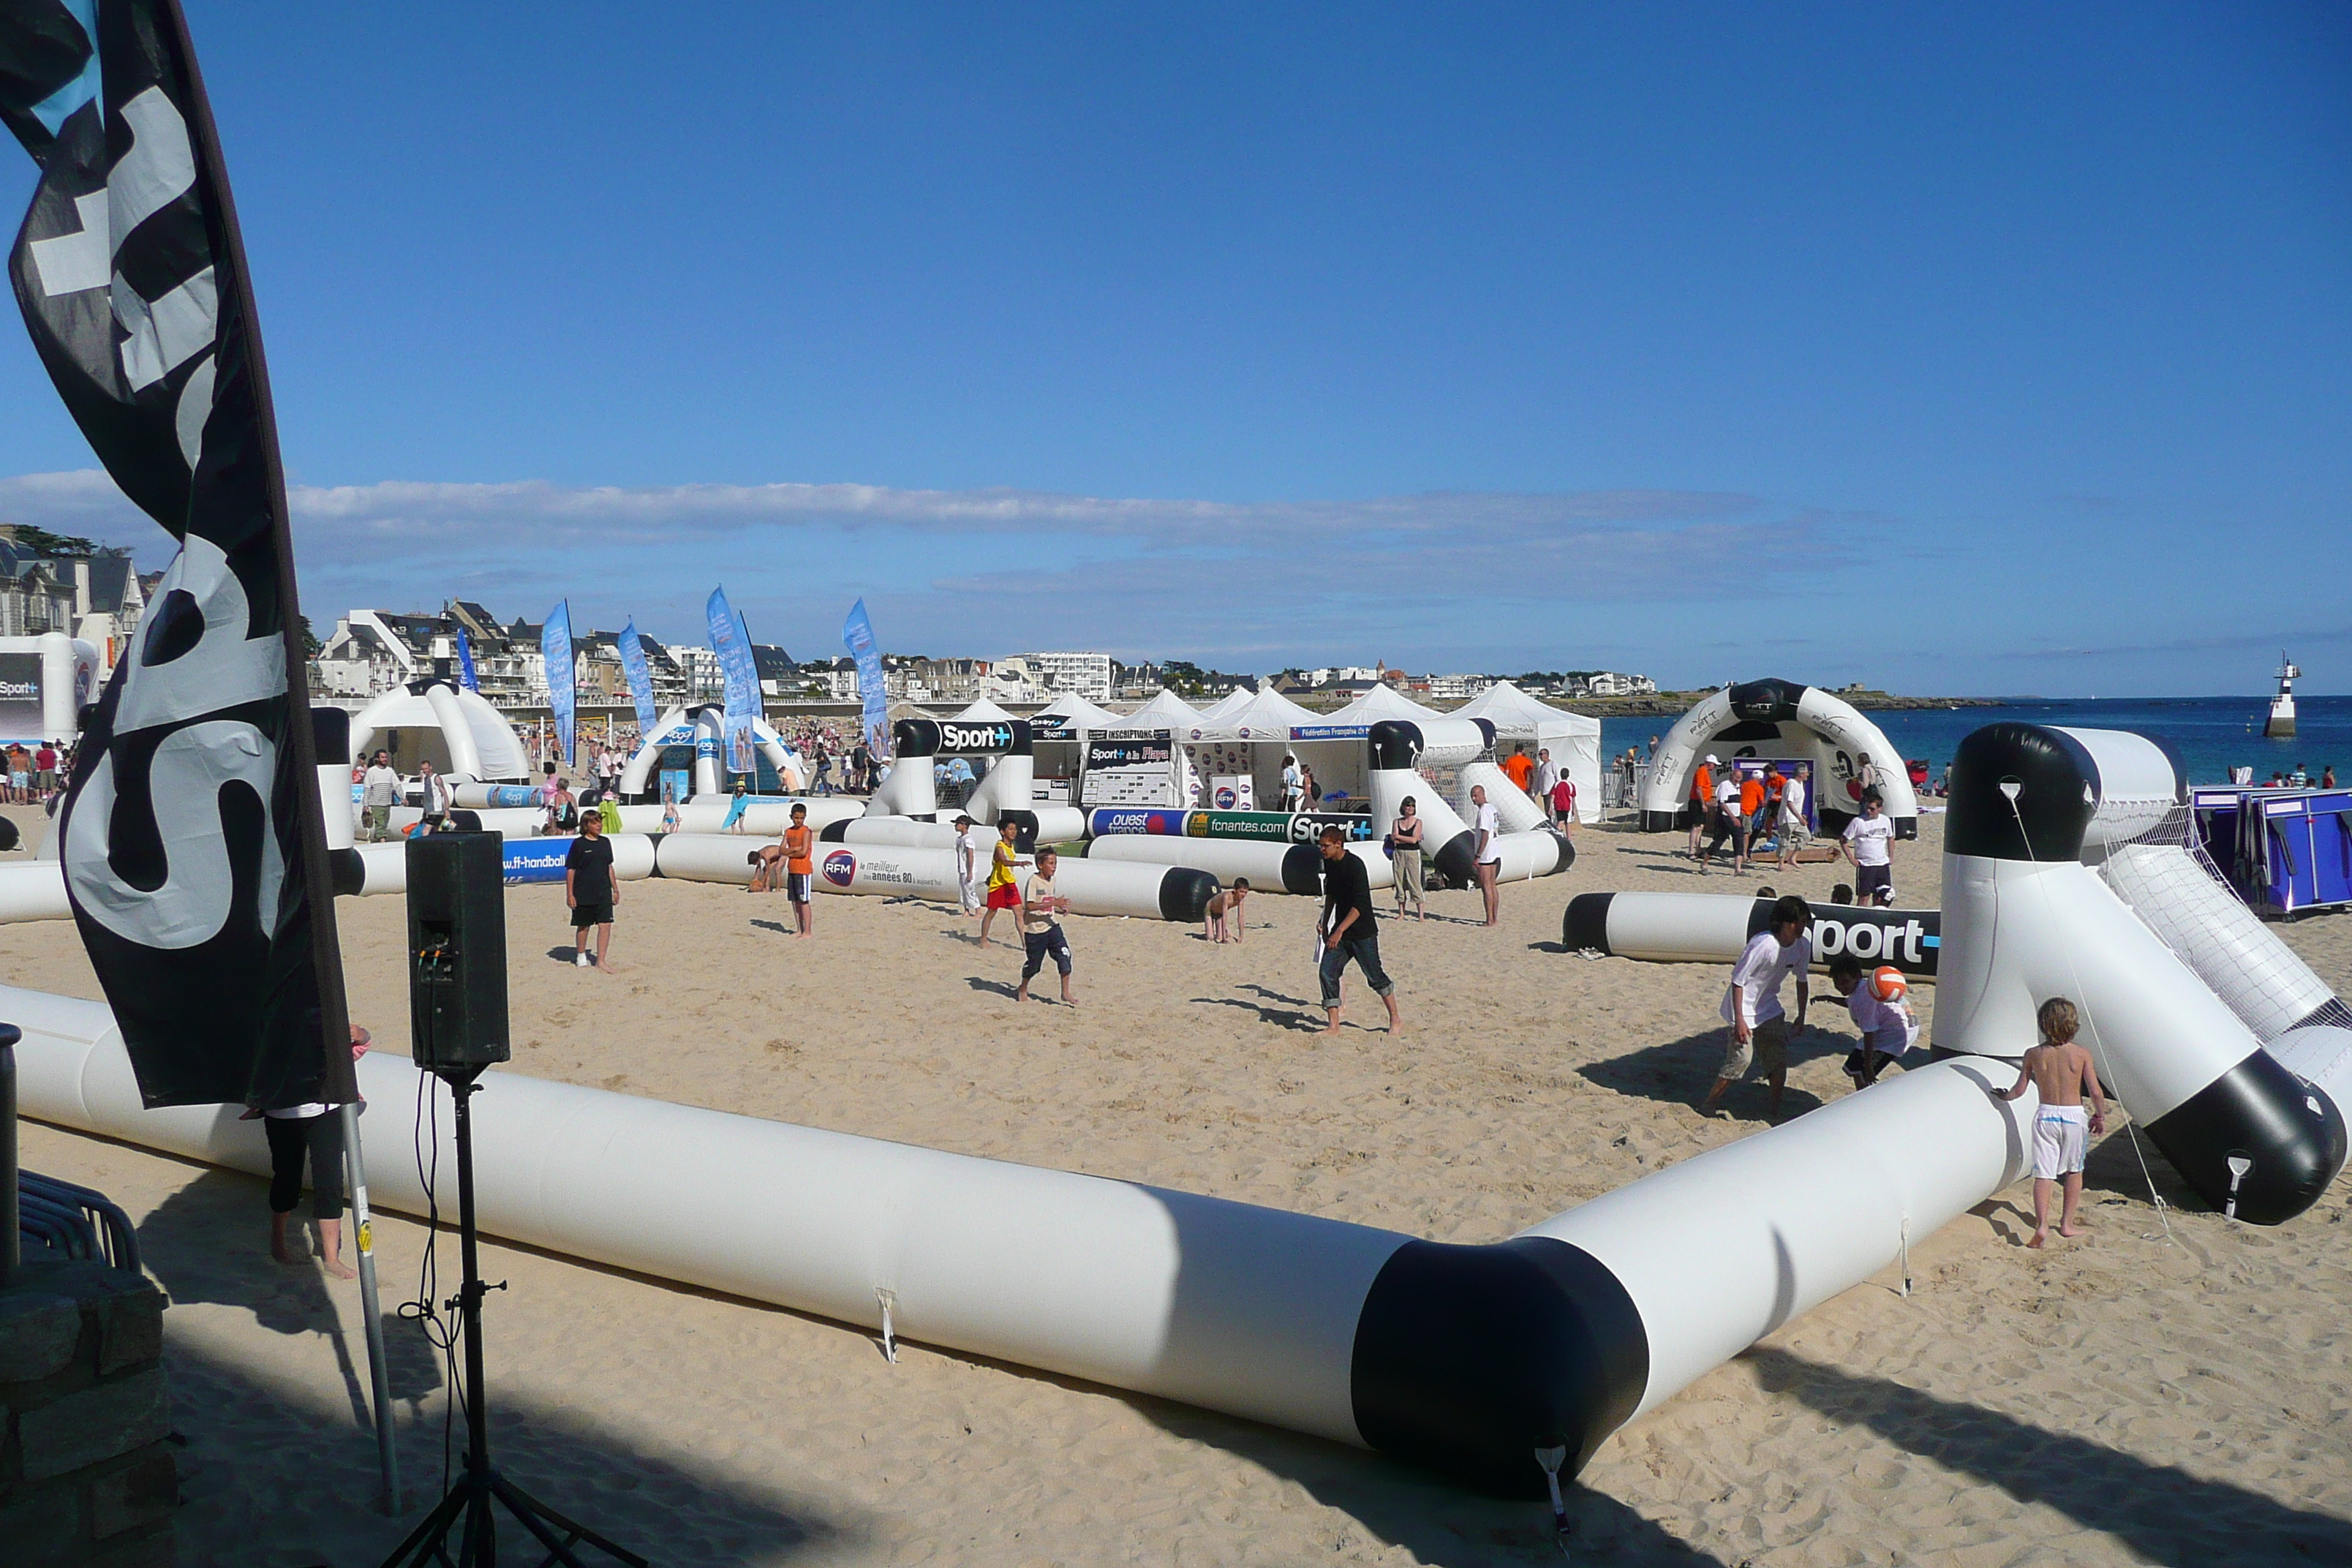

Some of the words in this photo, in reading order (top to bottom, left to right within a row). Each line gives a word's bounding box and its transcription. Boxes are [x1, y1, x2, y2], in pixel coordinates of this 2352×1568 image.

[0, 681, 38, 696] Sport+
[943, 725, 1010, 751] Sport+
[1043, 730, 1066, 739] Sport+
[1108, 730, 1154, 739] INSCRIPTIONS
[1302, 728, 1331, 736] Fédération
[1091, 748, 1125, 761] Sport+
[1142, 747, 1169, 761] Playa
[1112, 812, 1148, 826] ouest
[1211, 818, 1284, 833] fcnantes.com
[826, 863, 850, 875] RFM
[866, 861, 900, 872] meilleur
[872, 871, 902, 883] années
[902, 872, 912, 883] 80
